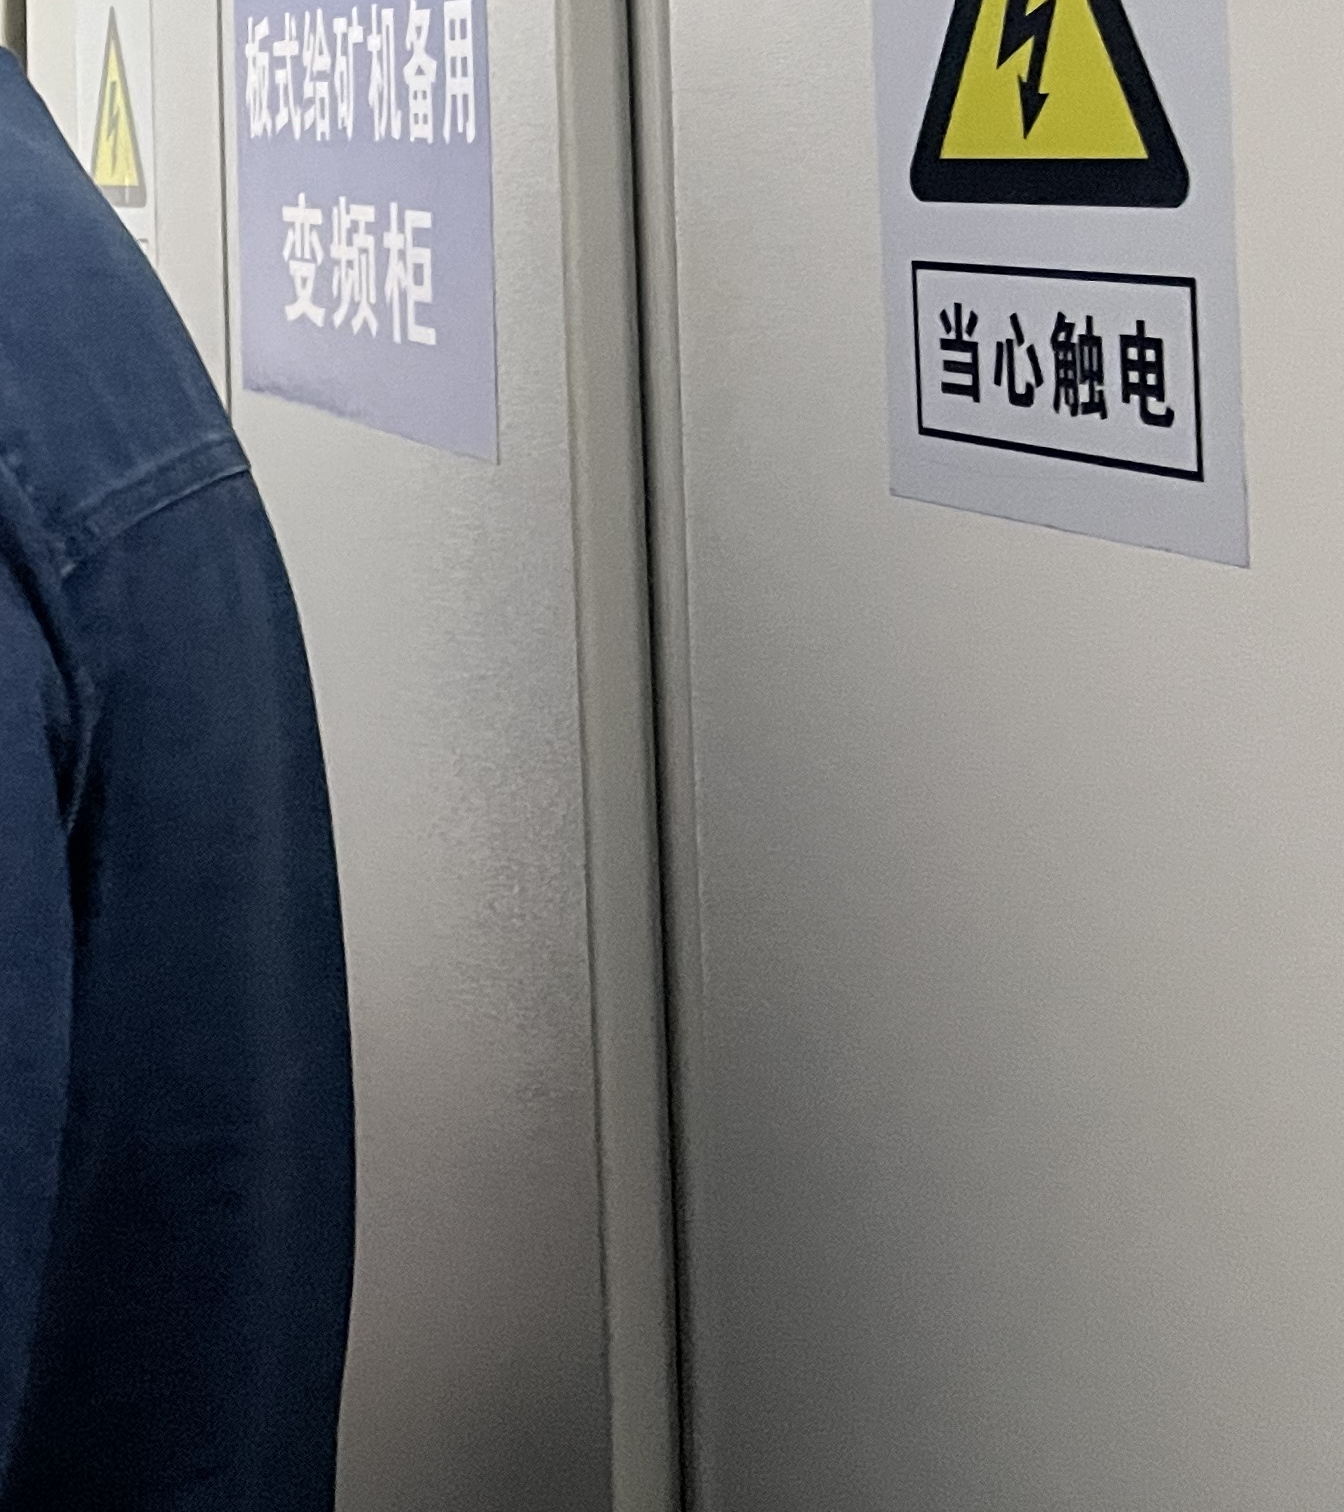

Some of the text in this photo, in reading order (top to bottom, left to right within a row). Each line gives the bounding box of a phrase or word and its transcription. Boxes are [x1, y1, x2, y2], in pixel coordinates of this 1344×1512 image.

[281, 192, 438, 347] 变频柜
[934, 300, 1177, 429] 当心触电
